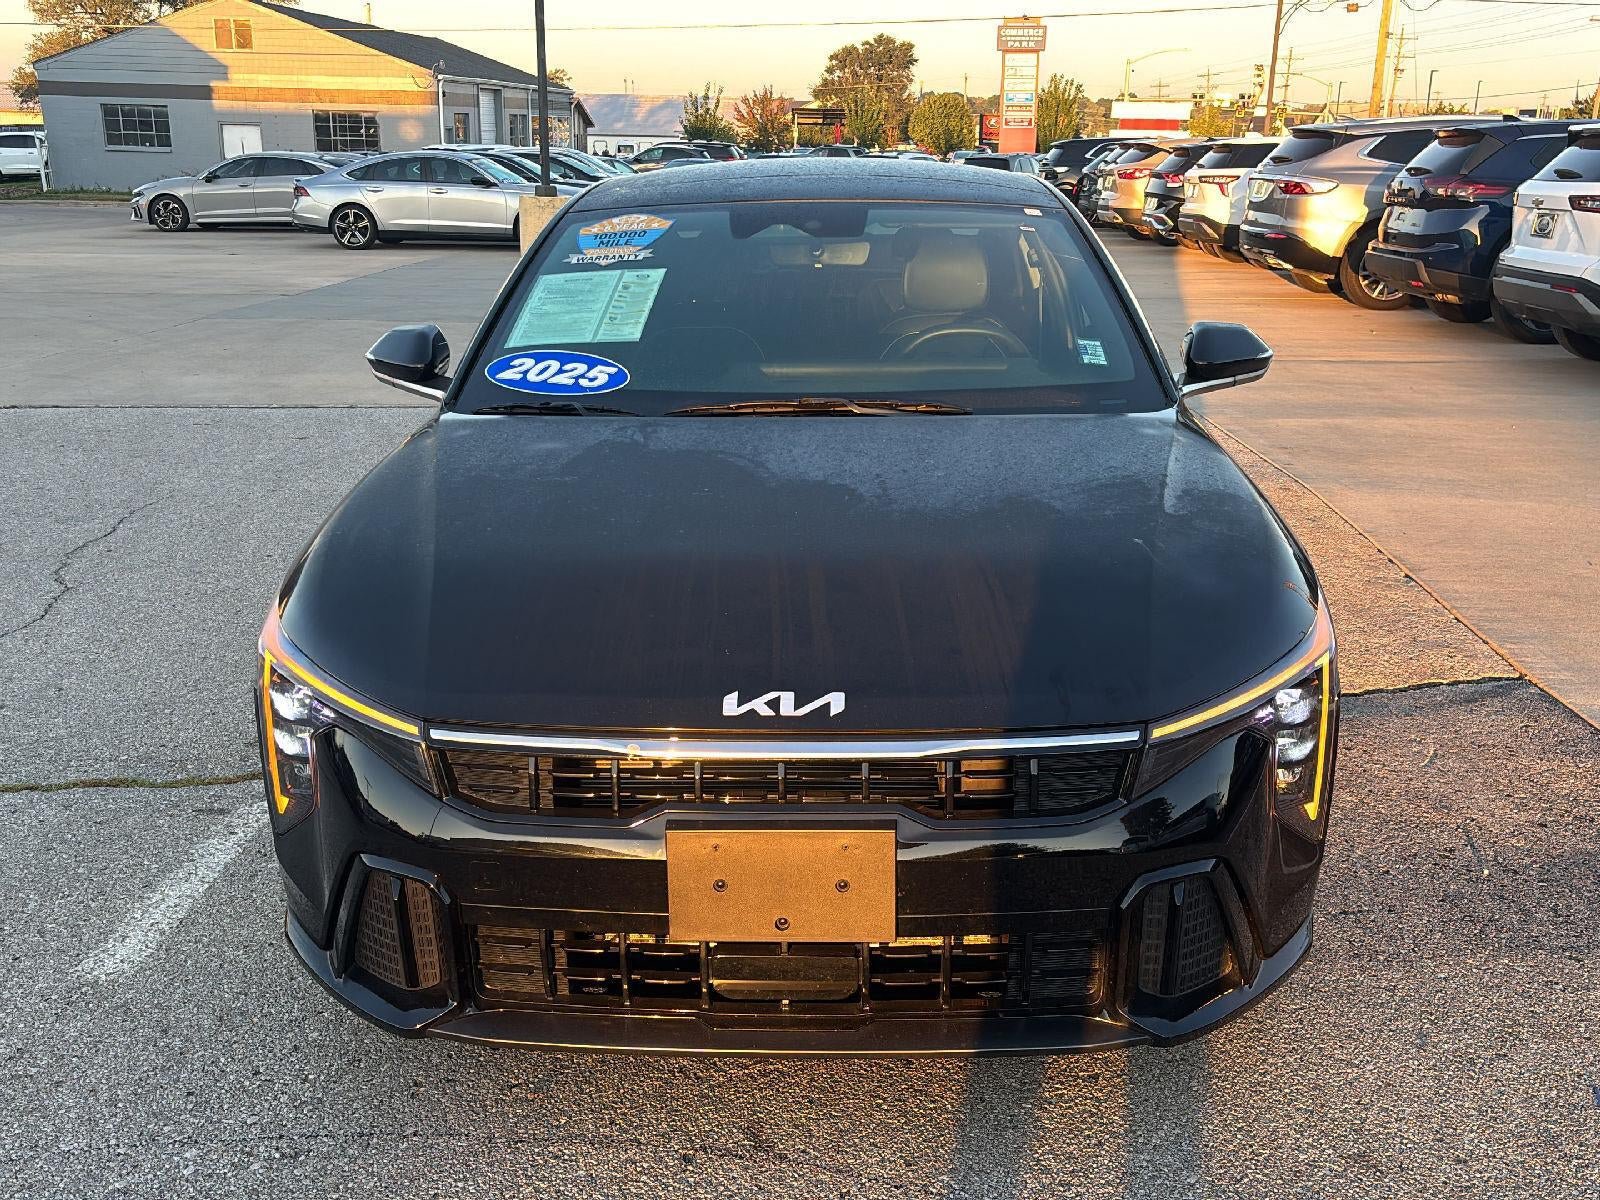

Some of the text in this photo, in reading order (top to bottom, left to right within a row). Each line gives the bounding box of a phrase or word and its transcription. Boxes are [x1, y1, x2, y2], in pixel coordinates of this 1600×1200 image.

[1000, 28, 1043, 36] COMMERCE
[616, 222, 646, 231] YEAR
[597, 239, 634, 248] MILE
[576, 253, 641, 263] WARRANTY
[495, 357, 619, 388] 2025
